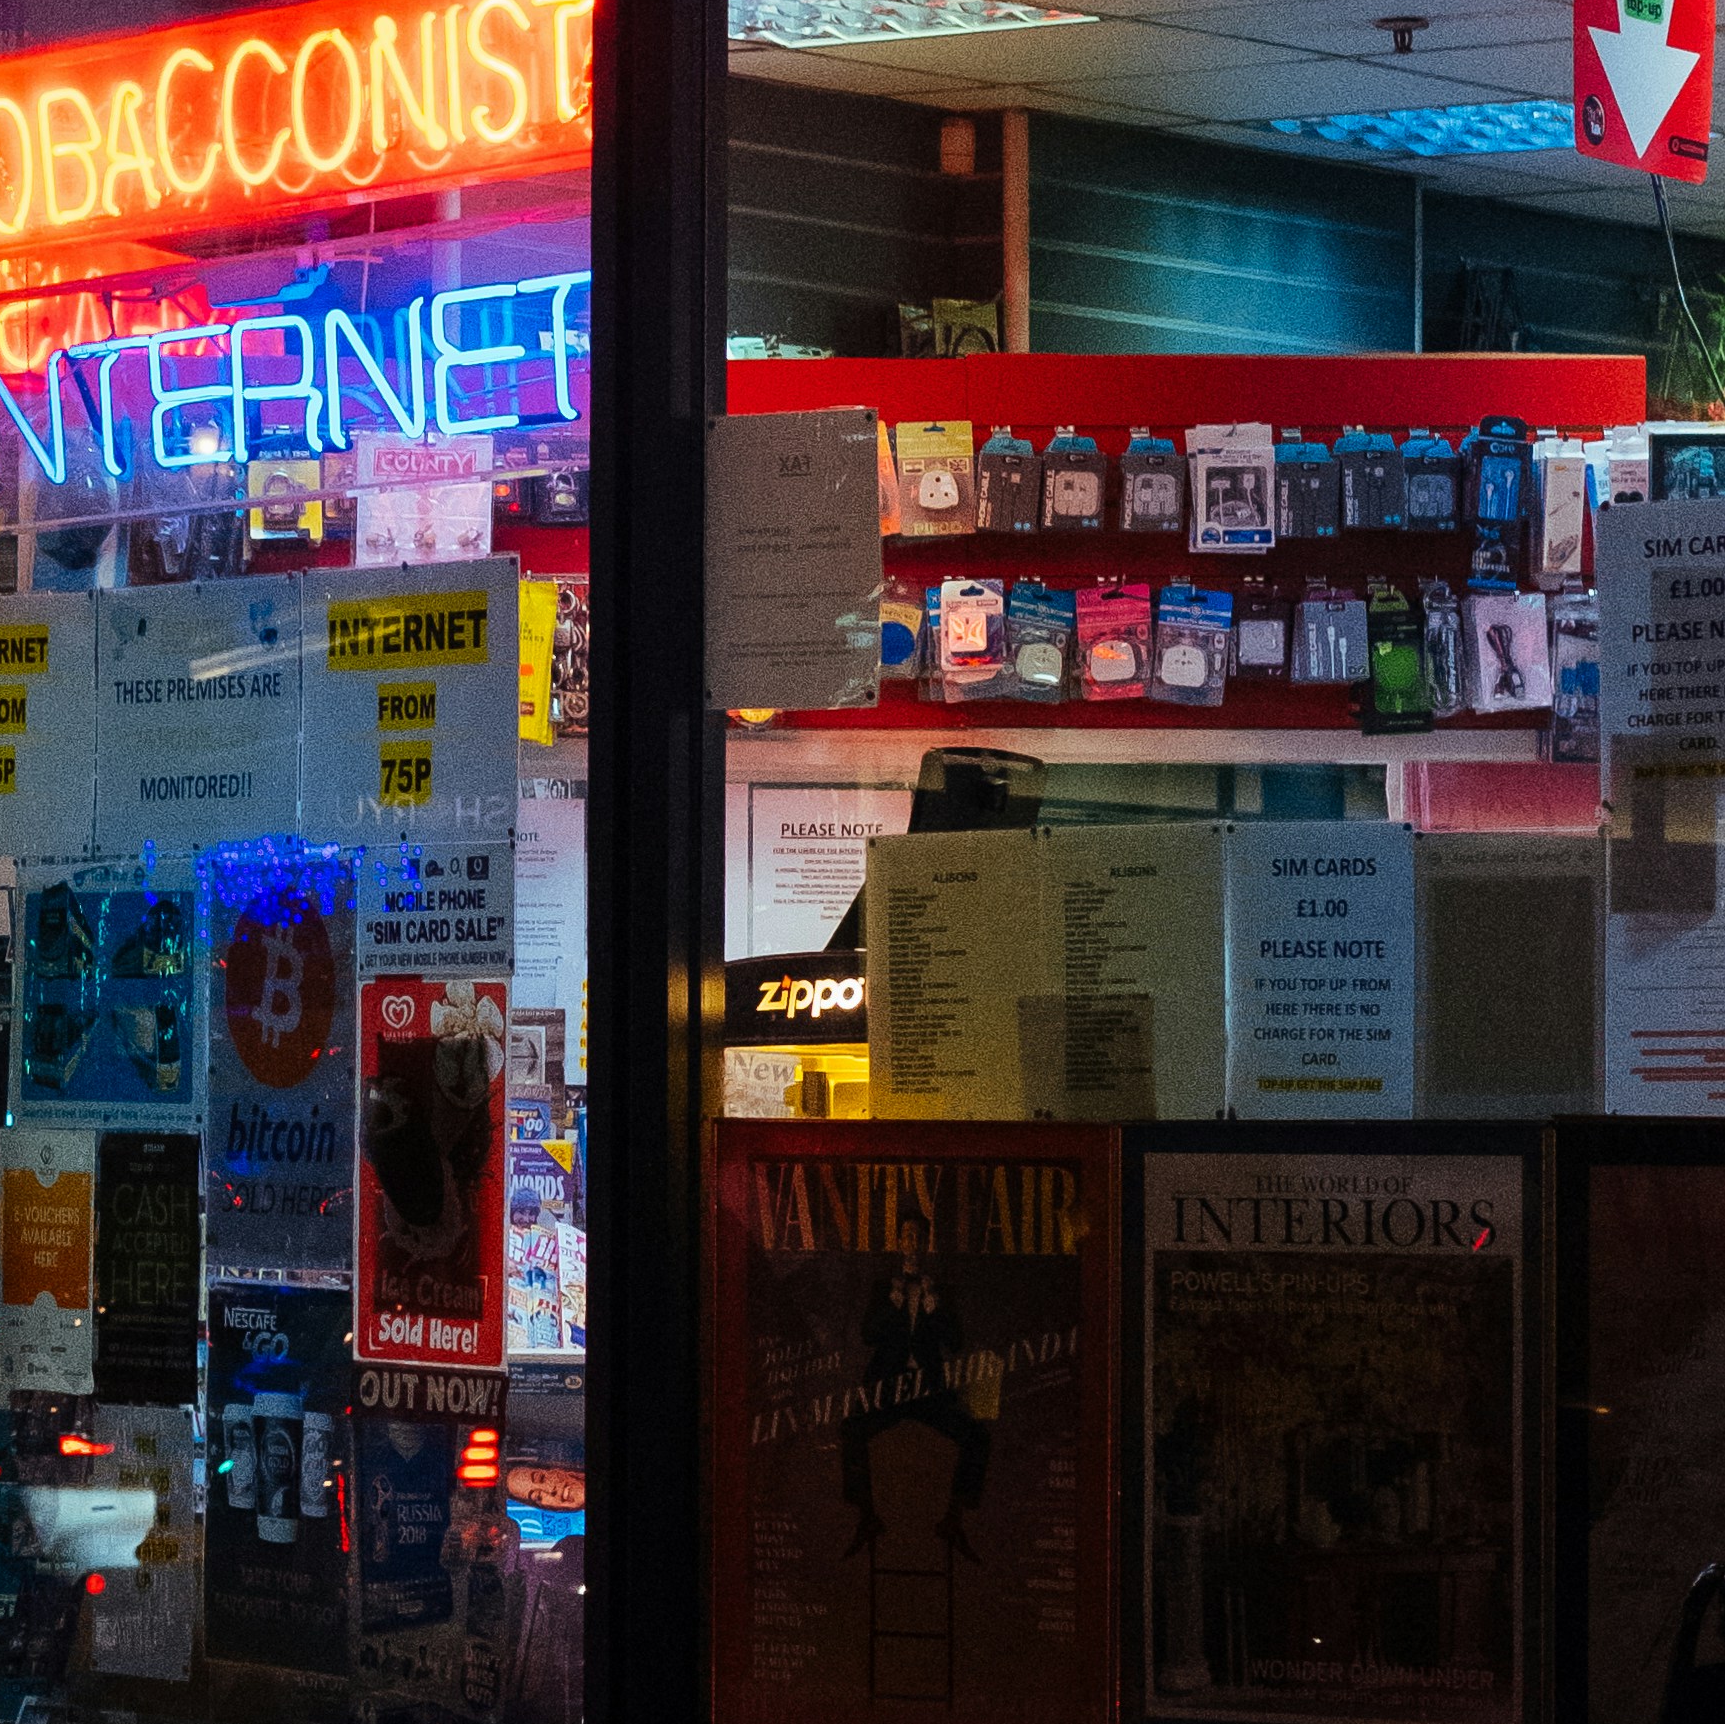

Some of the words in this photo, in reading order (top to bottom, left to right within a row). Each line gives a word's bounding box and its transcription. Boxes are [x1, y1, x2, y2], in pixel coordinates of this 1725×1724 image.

[379, 452, 474, 473] COUNTY
[1644, 538, 1681, 558] SIM
[329, 608, 487, 657] INTERNET
[1632, 622, 1701, 643] PLEASE
[1642, 662, 1671, 676] YOU
[1676, 660, 1702, 674] TOP
[114, 679, 161, 704] THESE
[166, 677, 246, 702] PREMISES
[250, 673, 281, 698] ARE
[1639, 687, 1673, 702] HERE
[1677, 686, 1720, 700] THERE
[378, 693, 435, 722] FROM
[1627, 713, 1683, 727] CHARGE
[1686, 712, 1716, 725] FOR
[382, 755, 431, 794] 75P
[140, 772, 252, 801] MONITORED!!
[781, 823, 836, 838] PLEASE
[841, 823, 883, 837] NOTE
[1271, 858, 1308, 876] SIM
[1314, 857, 1377, 876] CARDS
[384, 890, 435, 912] MOBILE
[439, 889, 485, 910] PHONE
[1296, 898, 1348, 918] £1.00
[406, 919, 450, 943] CARD
[1260, 939, 1327, 959] PLEASE
[1333, 939, 1385, 959] NOTE
[1254, 978, 1266, 991] IF
[1269, 978, 1297, 991] YOU
[1301, 978, 1326, 991] TOP
[1329, 978, 1347, 991] UP
[1352, 978, 1392, 992] FROM
[756, 975, 864, 1018] zippo
[1265, 1003, 1298, 1016] HERE
[1302, 1003, 1341, 1016] THERE
[1345, 1003, 1357, 1016] IS
[1359, 1003, 1381, 1016] NO
[1253, 1027, 1305, 1041] CHARGE
[1309, 1027, 1335, 1041] FOR
[1338, 1027, 1363, 1041] THE
[1366, 1027, 1392, 1041] SIM
[226, 1103, 336, 1163] bitcoin
[113, 1184, 190, 1226] CASH
[753, 1162, 944, 1254] VANITY
[953, 1164, 1079, 1256] FAIR
[1172, 1197, 1497, 1247] INTERIORS
[111, 1262, 190, 1307] HERE
[377, 1311, 425, 1348] Sold
[429, 1317, 478, 1356] Here!
[359, 1369, 420, 1408] OUT
[425, 1374, 501, 1416] NOW!
[396, 1503, 443, 1523] RUSSIA
[398, 1526, 427, 1545] 2018
